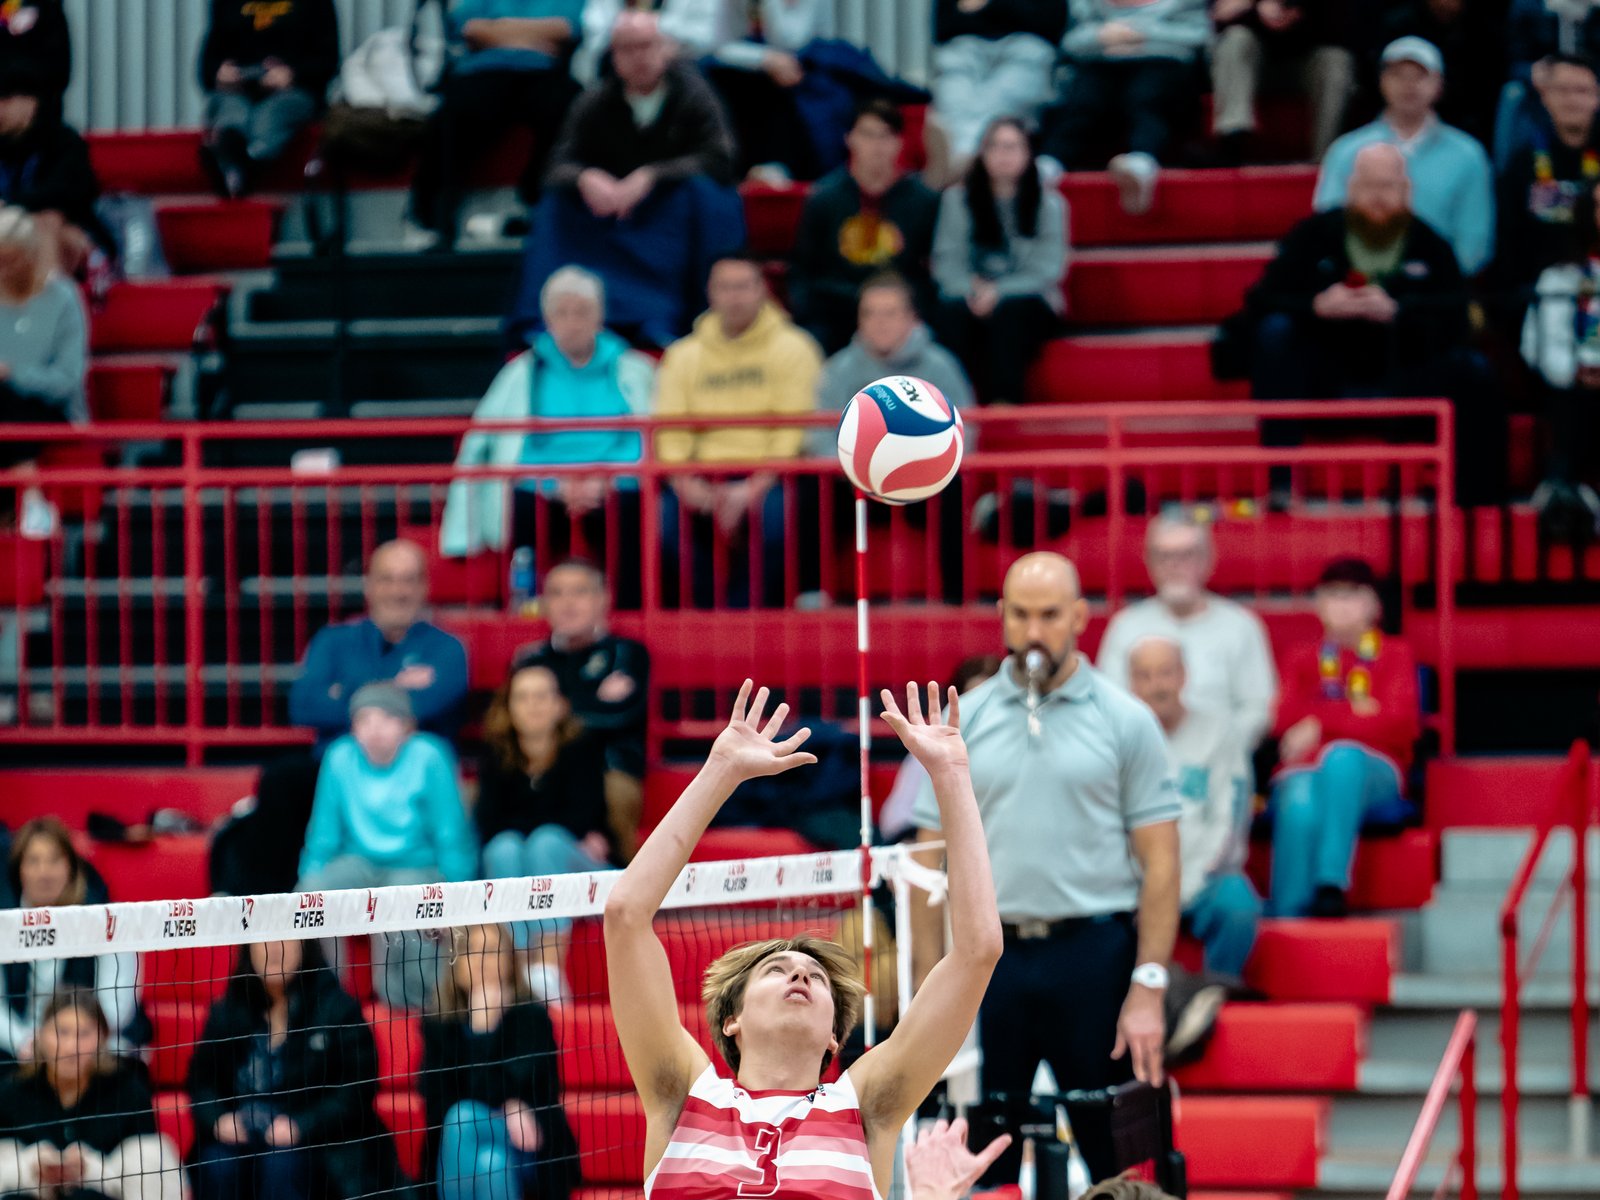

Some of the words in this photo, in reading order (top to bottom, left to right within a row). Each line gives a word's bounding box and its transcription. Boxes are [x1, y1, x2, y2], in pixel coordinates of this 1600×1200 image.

[531, 878, 553, 892] LEWS
[22, 909, 52, 927] LEWIS
[294, 910, 325, 929] FLYERS
[163, 919, 197, 938] FLYERS
[19, 928, 56, 949] FLYERS
[737, 1127, 782, 1197] 3
